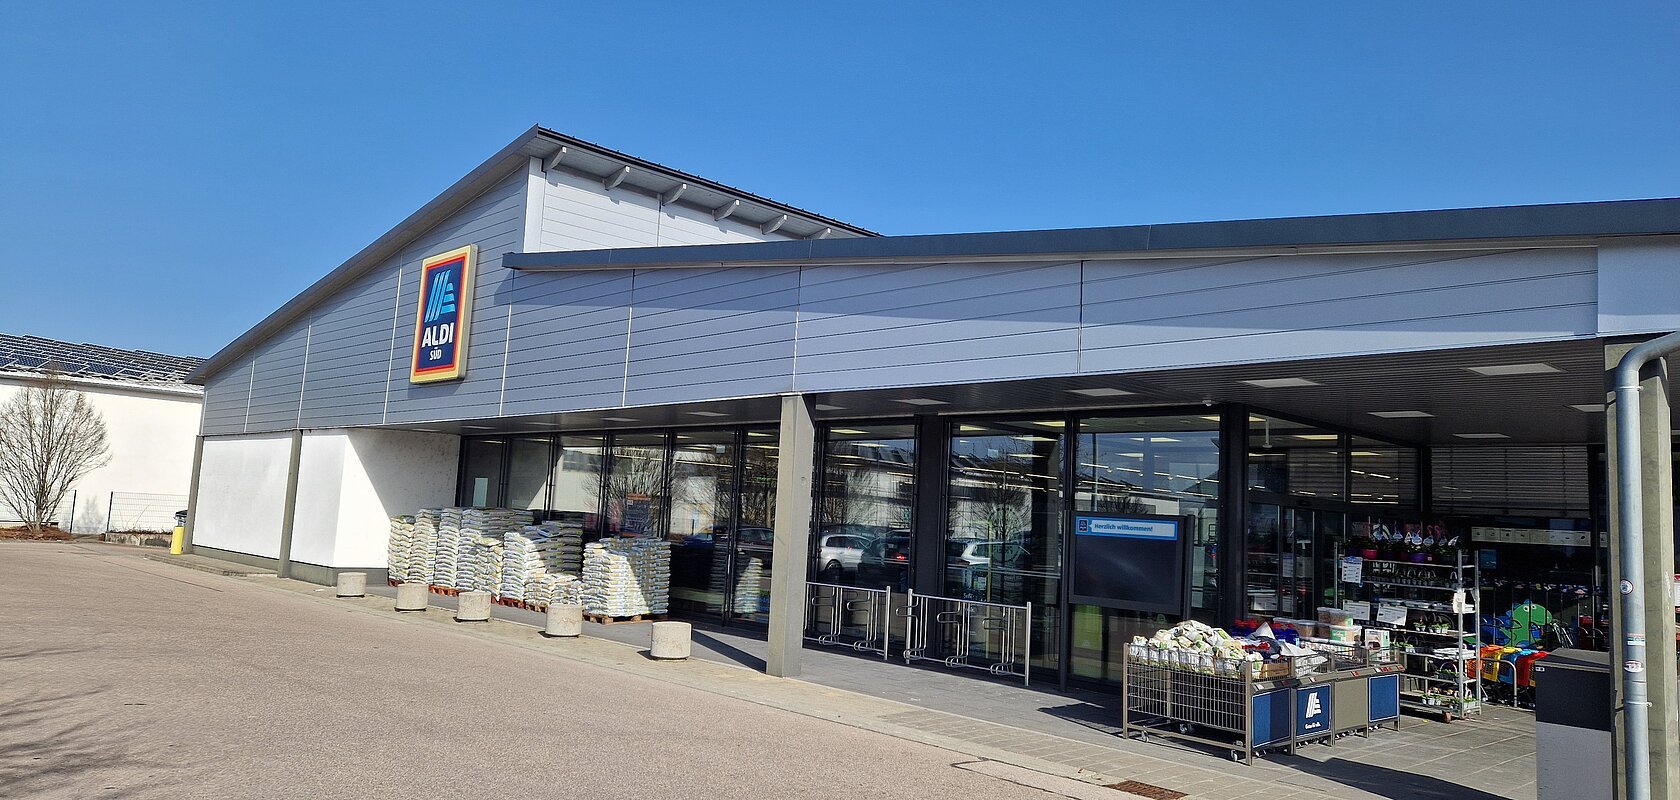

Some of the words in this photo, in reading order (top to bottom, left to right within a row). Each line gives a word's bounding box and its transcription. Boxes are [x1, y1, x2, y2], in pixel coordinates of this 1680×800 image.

[421, 322, 455, 348] ALDI
[429, 347, 442, 361] SÜD
[1117, 524, 1153, 532] willkommen!
